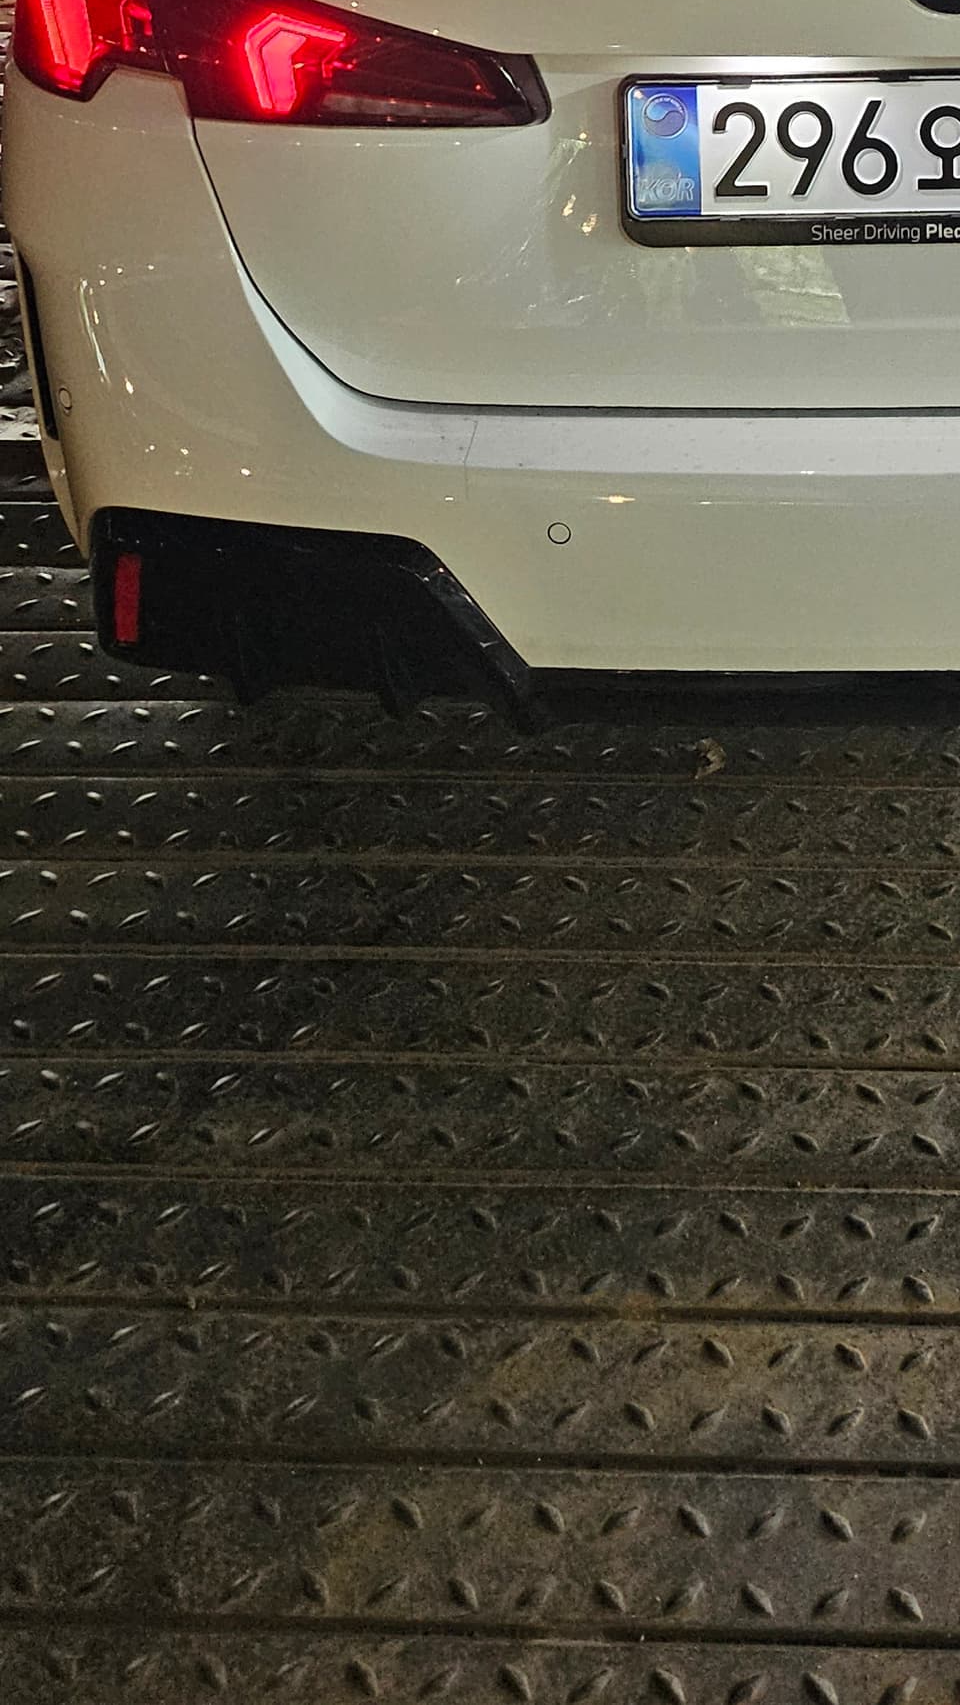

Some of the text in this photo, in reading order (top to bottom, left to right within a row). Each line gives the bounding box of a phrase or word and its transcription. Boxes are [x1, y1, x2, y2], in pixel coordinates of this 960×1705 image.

[639, 177, 695, 202] KOR
[811, 224, 860, 241] Sheer
[864, 224, 920, 242] Driving
